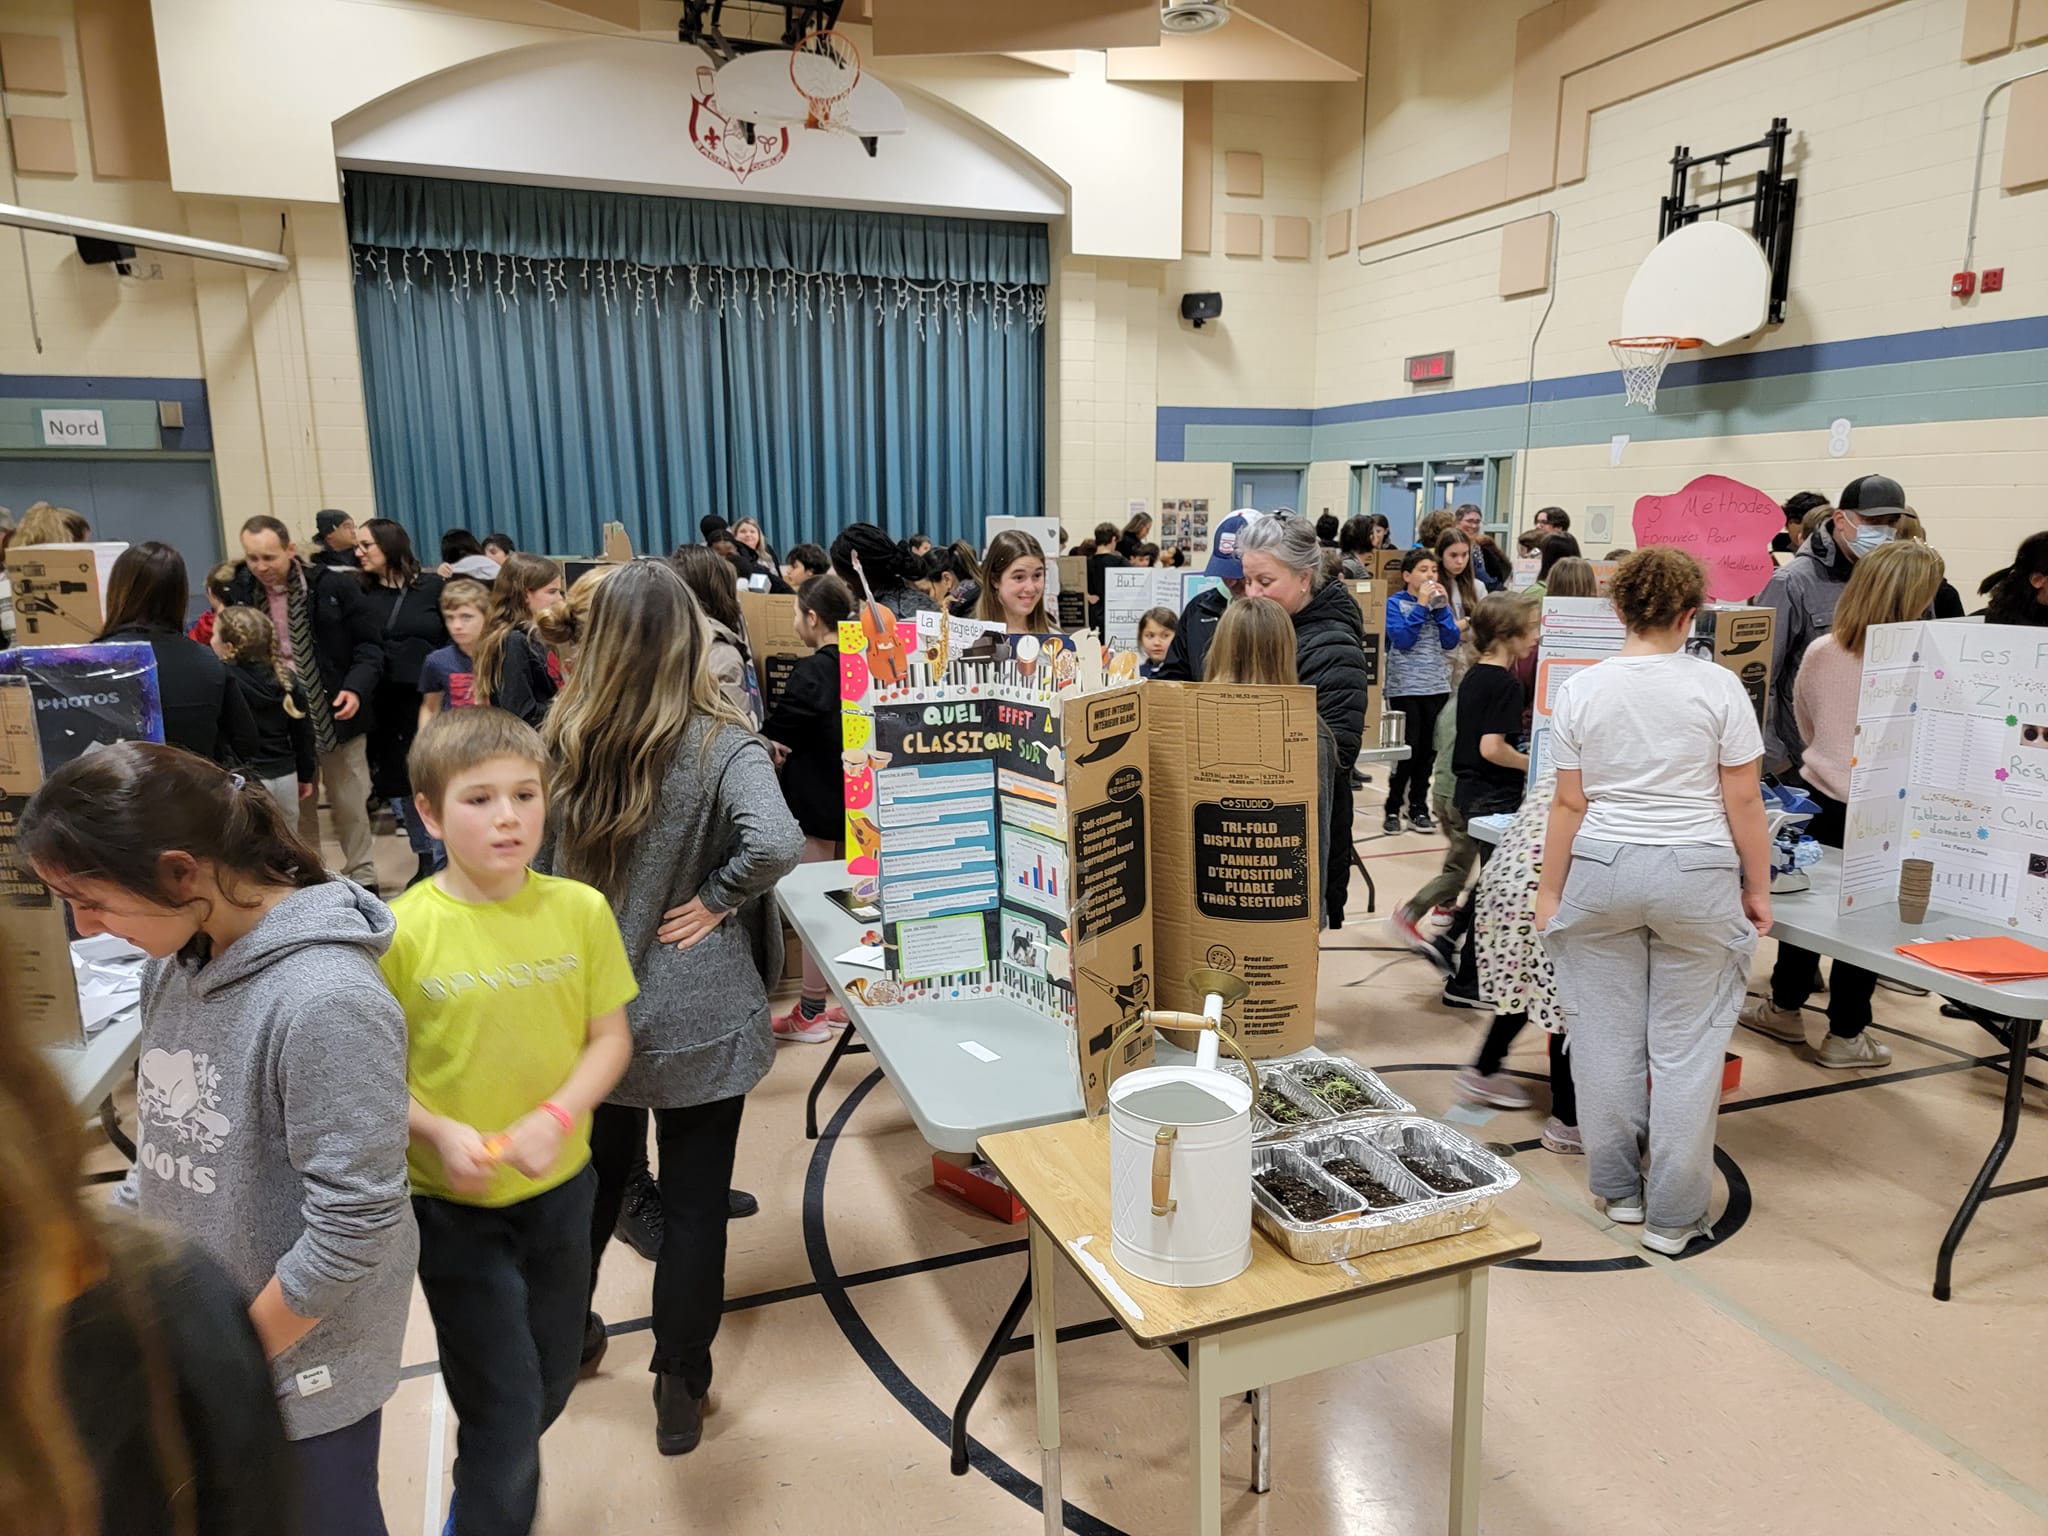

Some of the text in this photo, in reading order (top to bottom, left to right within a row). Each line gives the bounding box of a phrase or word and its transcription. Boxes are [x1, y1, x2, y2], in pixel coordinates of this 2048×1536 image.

[49, 420, 99, 435] Nord
[1829, 418, 1851, 457] 8
[1648, 492, 1771, 522] 3 Méthodes
[1707, 527, 1736, 543] Pour
[1960, 632, 2011, 665] Les
[38, 692, 120, 711] PHOTOS
[923, 703, 1054, 733] QUEL EFFET A
[902, 731, 1041, 764] CLASSIQUE SUR
[1235, 799, 1269, 809] STUDIO
[1954, 811, 1972, 822] de
[1221, 821, 1278, 834] TRI-FOLD
[1203, 834, 1301, 849] DISPLAY BOARD
[1220, 854, 1278, 867] PANNEAU
[1208, 866, 1293, 880] D'EXPOSITION
[1225, 881, 1275, 894] PLIABLE
[1202, 892, 1302, 908] TROIS SECTIONS
[420, 953, 578, 1000] SPYDER
[138, 1118, 216, 1194] oots
